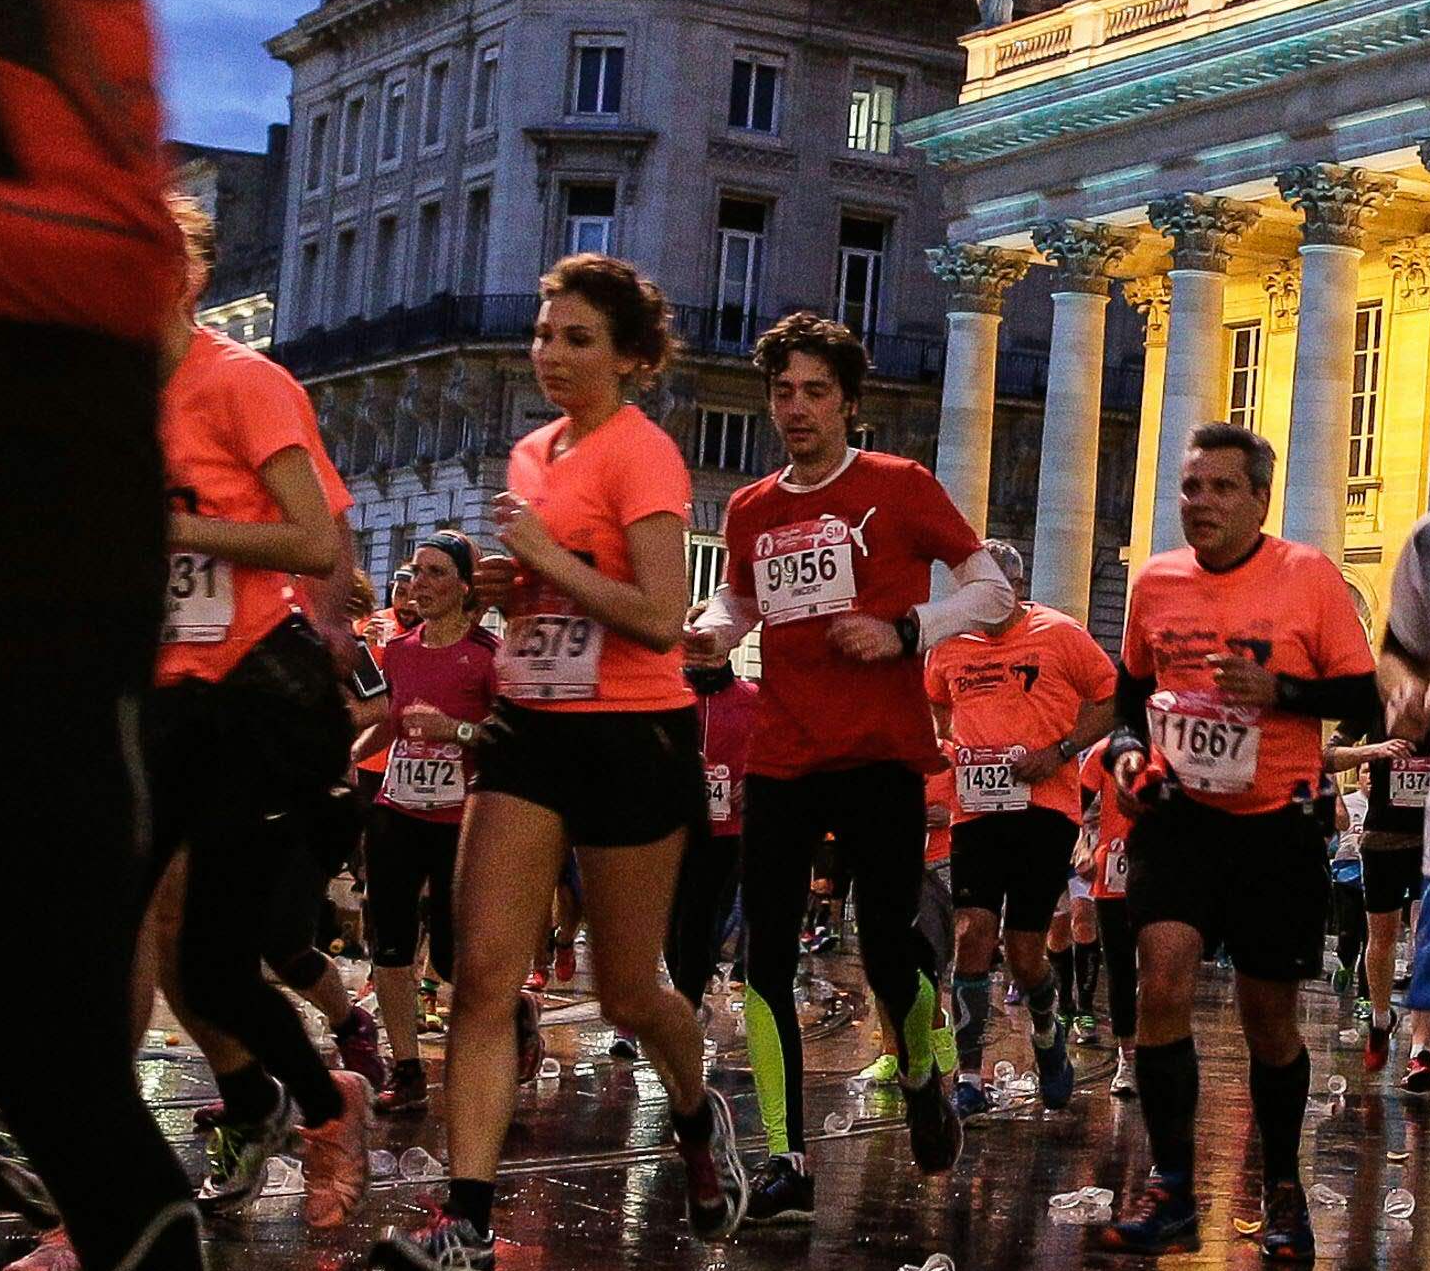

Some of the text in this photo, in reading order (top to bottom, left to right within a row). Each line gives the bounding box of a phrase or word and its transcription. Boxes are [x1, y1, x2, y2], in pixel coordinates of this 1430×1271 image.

[767, 549, 837, 591] 9956
[1160, 714, 1247, 760] 11667
[396, 760, 456, 785] 11472
